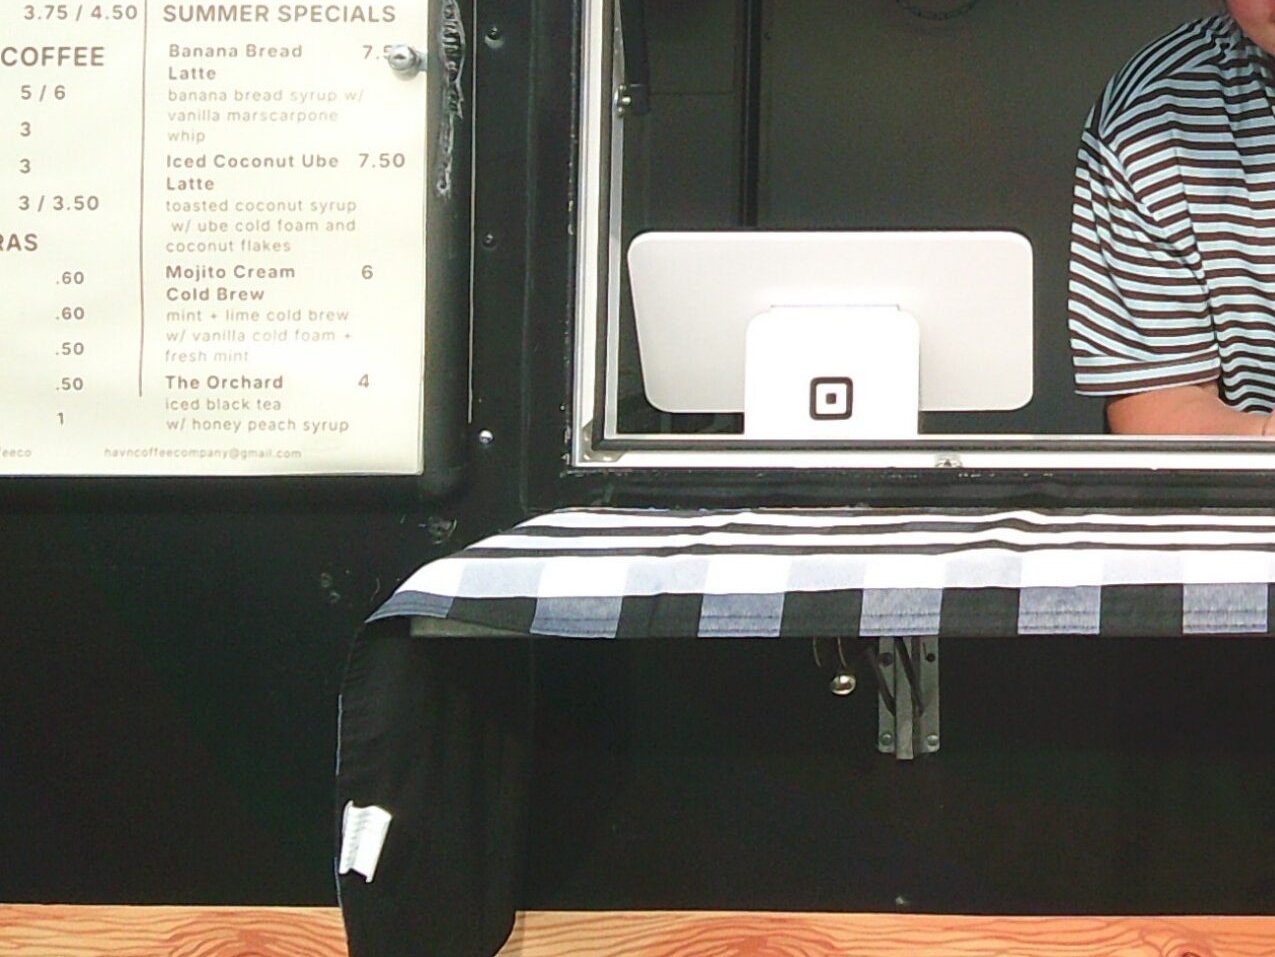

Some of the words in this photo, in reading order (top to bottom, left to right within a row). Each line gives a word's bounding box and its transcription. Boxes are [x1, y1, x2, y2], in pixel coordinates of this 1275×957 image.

[24, 5, 68, 20] 3.75
[91, 5, 137, 20] 4.50
[163, 4, 269, 22] SUMMER
[277, 4, 395, 22] SPECIALS
[1, 46, 104, 67] COFFEE
[169, 44, 238, 57] Banana
[246, 44, 302, 58] Bread
[169, 67, 216, 80] Latte
[21, 85, 32, 100] 5
[54, 85, 65, 100] 6
[168, 88, 227, 101] banana
[234, 89, 283, 101] bread
[290, 91, 337, 104] syrup
[344, 89, 364, 102] w/
[168, 109, 220, 122] vanilla
[227, 111, 338, 123] marscarpone
[20, 121, 31, 137] 3
[168, 130, 205, 144] whip
[20, 158, 31, 174] 3
[167, 154, 206, 168] Iced
[213, 154, 294, 168] Coconut
[302, 154, 339, 168] Ube
[359, 153, 405, 168] 7.50
[167, 177, 214, 191] Latte
[19, 195, 29, 211] 3
[53, 195, 99, 211] 3.50
[166, 199, 228, 212] toasted
[235, 200, 302, 212] coconut
[310, 201, 357, 215] syrup
[171, 220, 191, 233] w/
[198, 220, 228, 232] ube
[235, 219, 270, 232] cold
[277, 218, 318, 232] foam
[325, 219, 356, 231] and
[166, 241, 233, 253] coconut
[241, 239, 291, 252] flakes
[56, 271, 84, 284] .60
[166, 265, 226, 282] Mojito
[234, 265, 295, 278] Cream
[362, 265, 373, 279] 6
[166, 287, 209, 301] Cold
[217, 287, 264, 301] Brew
[56, 307, 84, 320] .60
[166, 309, 201, 321] mint
[226, 308, 260, 321] lime
[266, 308, 301, 322] cold
[308, 309, 349, 321] brew
[166, 329, 186, 342] w/
[192, 329, 245, 342] vanilla
[252, 329, 288, 342] cold
[295, 328, 335, 341] foam
[56, 342, 84, 355] .50
[165, 349, 206, 363] fresh
[213, 351, 248, 363] mint
[56, 377, 83, 391] .50
[165, 375, 199, 389] The
[207, 375, 283, 389] Orchard
[358, 374, 369, 388] 4
[165, 398, 200, 410] iced
[206, 398, 250, 410] black
[257, 399, 281, 411] tea
[57, 412, 63, 425] 1
[166, 417, 186, 431] w/
[192, 418, 241, 433] honey
[248, 419, 296, 433] peach
[303, 421, 349, 434] syrup
